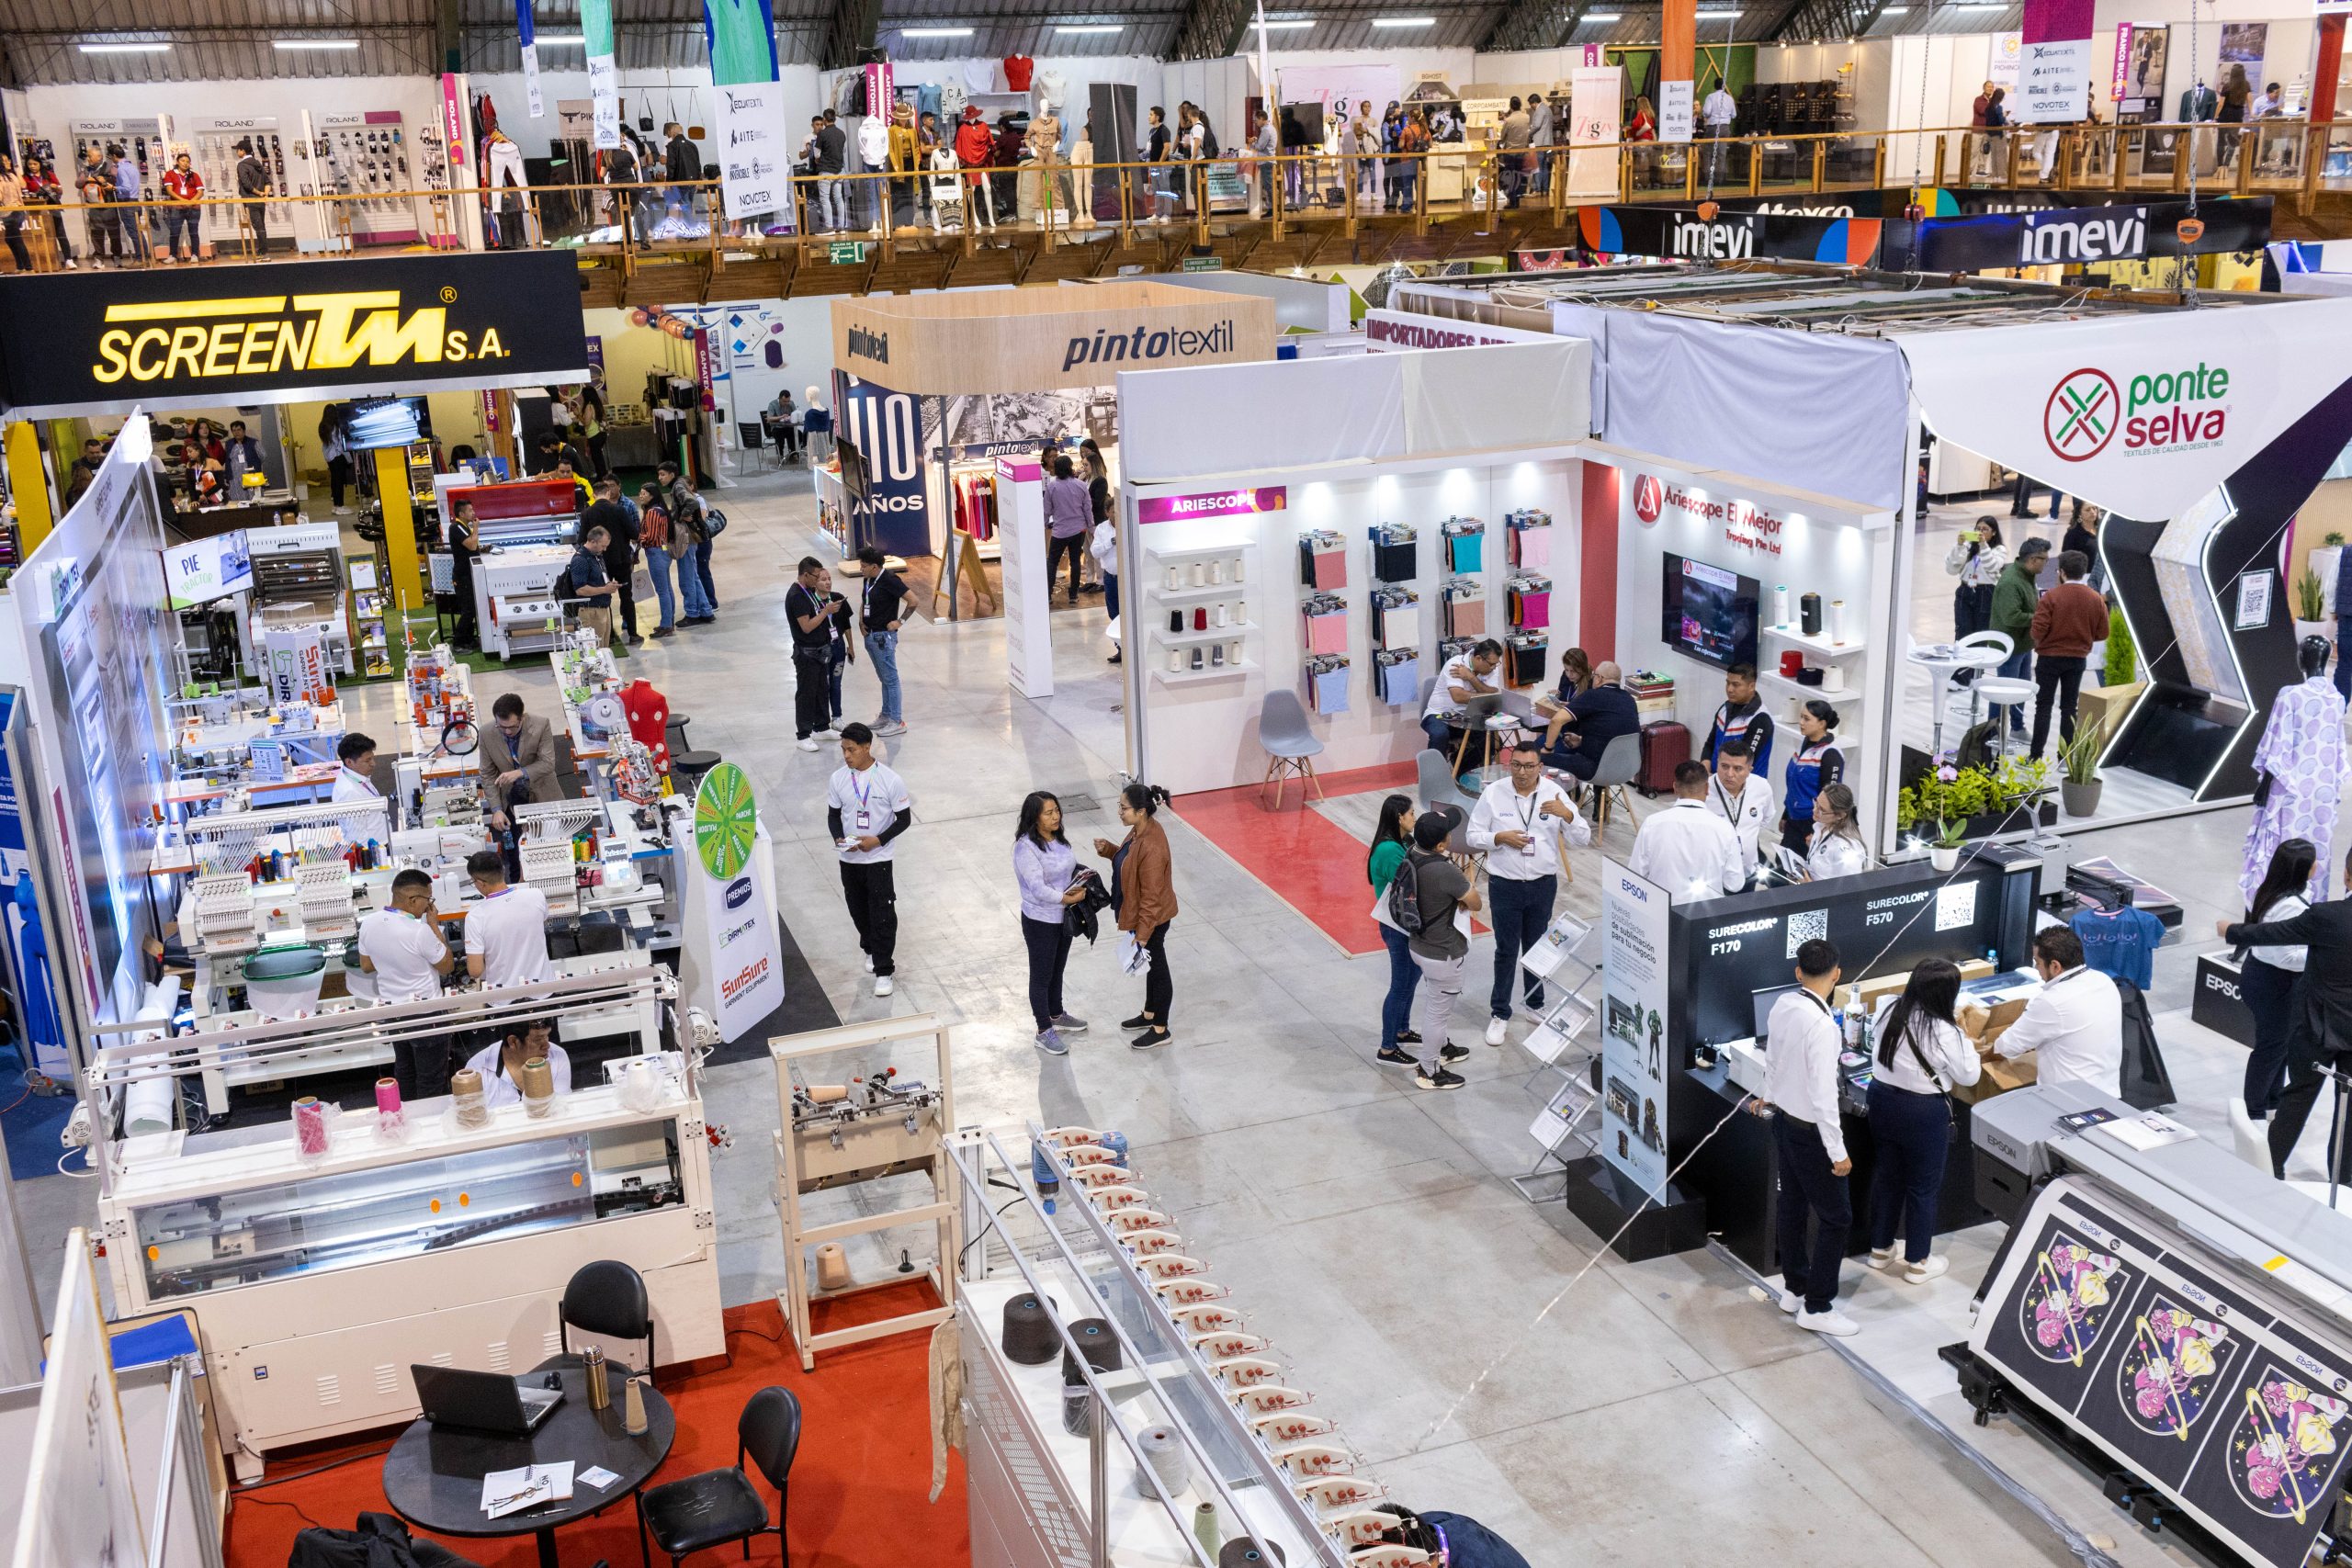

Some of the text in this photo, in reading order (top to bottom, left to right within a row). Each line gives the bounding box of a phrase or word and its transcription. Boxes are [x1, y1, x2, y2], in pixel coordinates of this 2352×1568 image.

[2115, 27, 2129, 97] FRANCO BUCHELI
[1465, 101, 1507, 110] CORPOAMBATO
[2032, 101, 2070, 109] NOVOTEX
[214, 119, 255, 128] ROLAND
[447, 99, 458, 140] ROLAND
[739, 190, 772, 207] NOVOTEX
[1674, 212, 1753, 259] imevi
[2022, 208, 2147, 262] imevi
[446, 328, 511, 361] S.A.
[1062, 319, 1233, 372] pintotextil
[700, 350, 710, 390] GAMATEX
[2128, 362, 2229, 417] ponte
[2124, 405, 2225, 447] selva
[985, 441, 1039, 457] pintotextil
[2123, 448, 2152, 457] TEXTILES
[2162, 445, 2188, 454] CALIDAD
[853, 493, 924, 515] AÑOS
[1171, 492, 1256, 513] ARIESCOPE
[1664, 485, 1724, 520] Ariescope
[1743, 508, 1782, 536] Mejor
[181, 554, 200, 576] PIE
[727, 881, 752, 903] PREMIOS
[1622, 878, 1647, 903] EPSON
[1611, 900, 1631, 919] Nuevas
[1866, 911, 1894, 926] F570
[728, 918, 755, 942] DIRMATEX
[1611, 911, 1645, 938] posibilidades
[1611, 921, 1655, 953] de sublimación
[1611, 931, 1624, 944] para
[1633, 942, 1657, 964] negocio
[1711, 939, 1741, 955] F170
[721, 955, 768, 1000] SunSure
[2206, 973, 2243, 1001] EPSO
[725, 972, 770, 1010] GARMENT EQUIPMENT
[1987, 1134, 2017, 1159] EPSON
